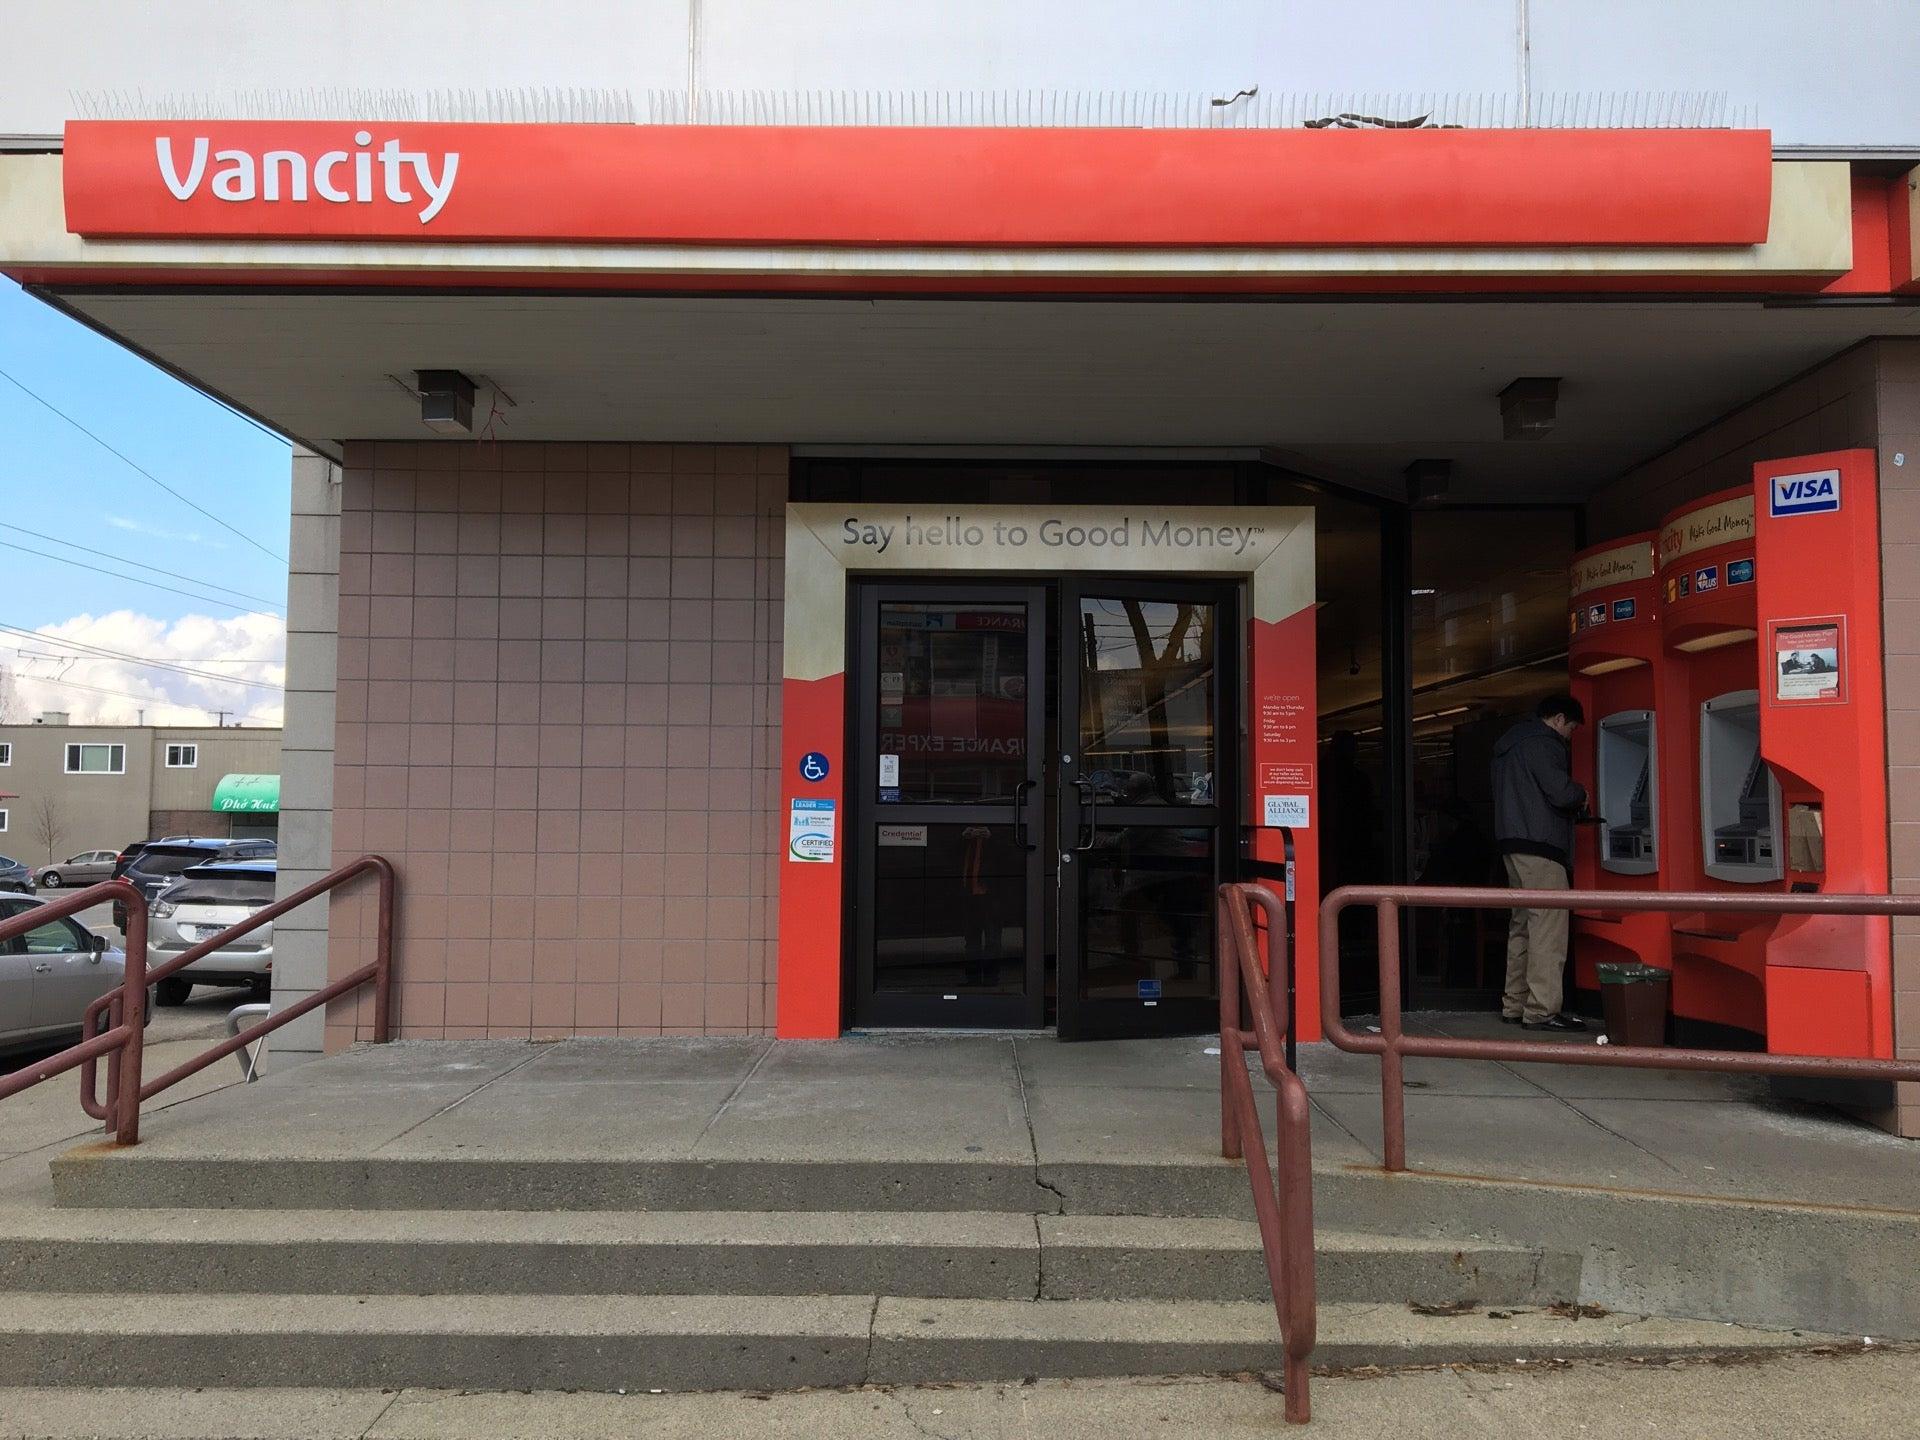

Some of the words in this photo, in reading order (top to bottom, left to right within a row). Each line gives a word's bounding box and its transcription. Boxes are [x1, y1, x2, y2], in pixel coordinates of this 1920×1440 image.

[155, 130, 460, 224] Vancity
[1777, 478, 1834, 500] VISA
[843, 517, 895, 554] Say
[905, 515, 984, 546] hello
[994, 521, 1028, 547] to
[1039, 517, 1129, 547] Good
[801, 839, 834, 847] CERTIFIED
